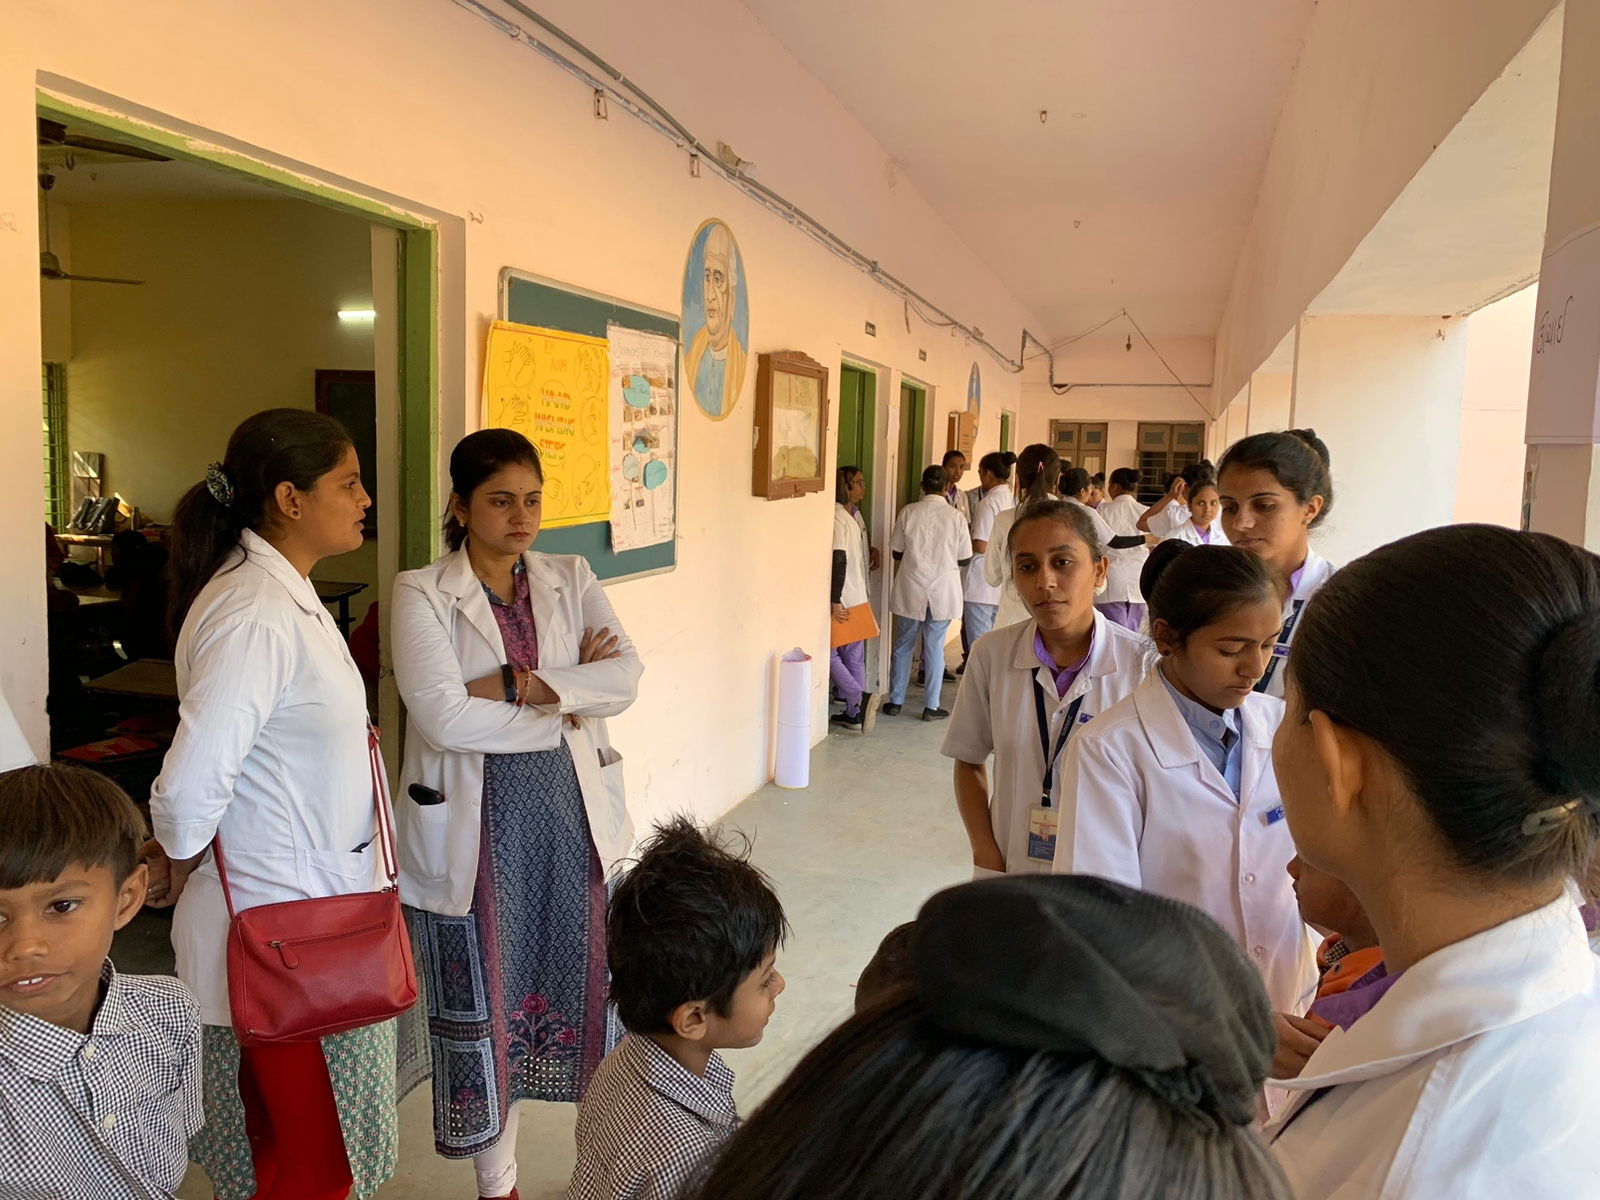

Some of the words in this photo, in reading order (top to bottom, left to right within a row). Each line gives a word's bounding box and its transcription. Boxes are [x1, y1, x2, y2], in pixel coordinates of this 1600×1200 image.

[541, 387, 572, 411] HAND
[534, 412, 576, 437] WASHING
[539, 438, 567, 461] STEPS
